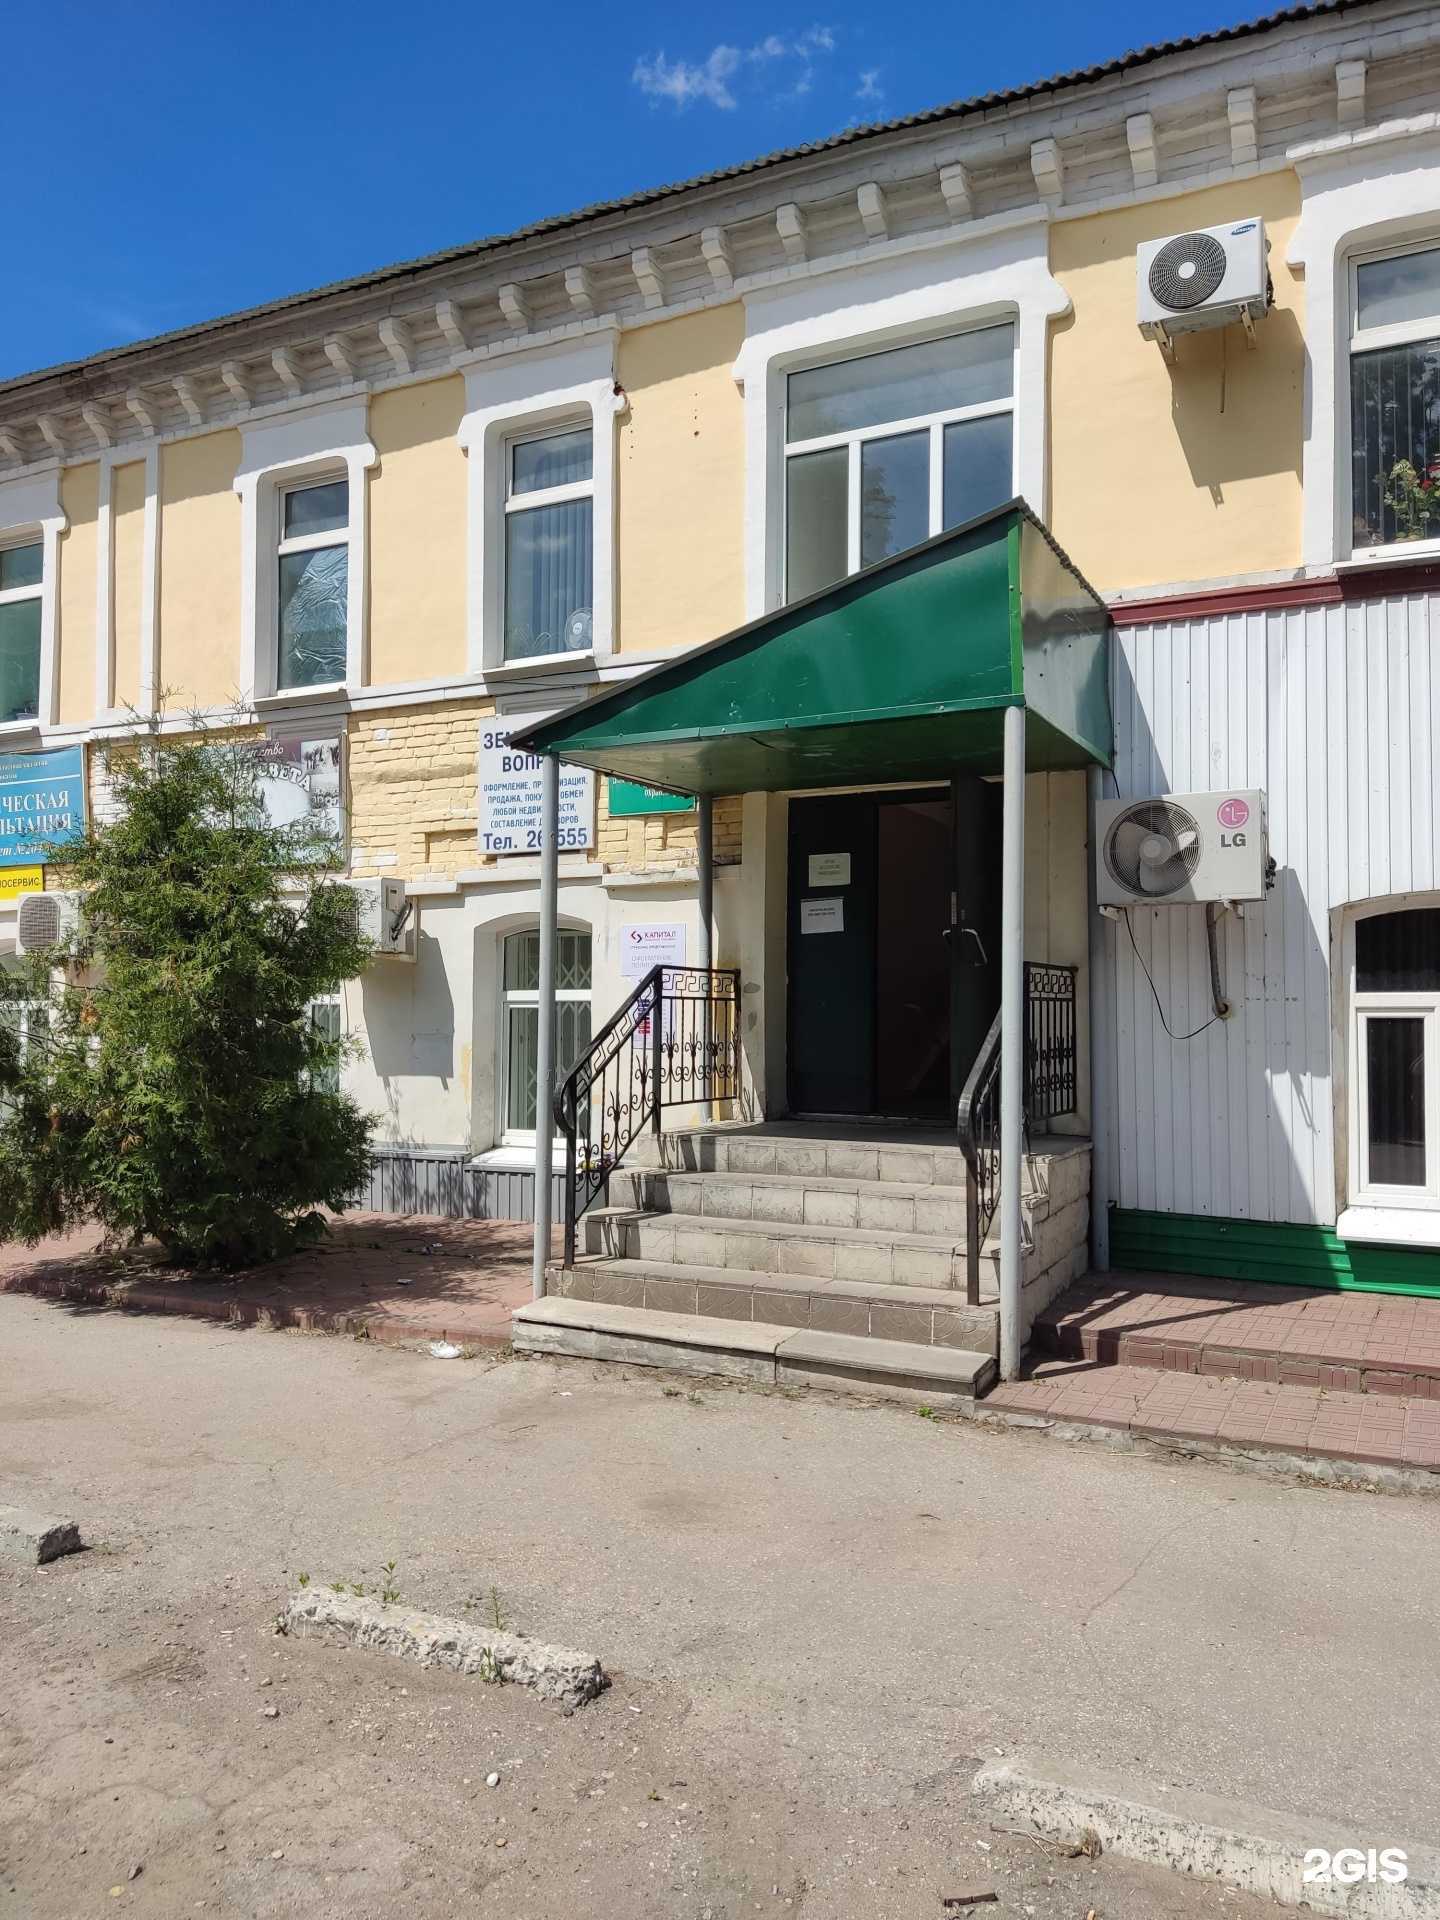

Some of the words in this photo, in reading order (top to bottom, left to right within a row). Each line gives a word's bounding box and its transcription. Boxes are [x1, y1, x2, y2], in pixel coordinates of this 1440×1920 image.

[483, 781, 531, 792] ОФОРМЛЕНИЕ,
[0, 790, 69, 813] ЧЕСКАЯ
[525, 793, 544, 803] ПОКУ
[560, 790, 584, 800] ОБМЕН
[492, 805, 517, 816] ЛЮБОЙ
[490, 818, 537, 829] СОСТАВЛЕНИЕ
[483, 832, 518, 851] Тел.
[527, 828, 588, 849] 26555
[1220, 833, 1247, 848] LG
